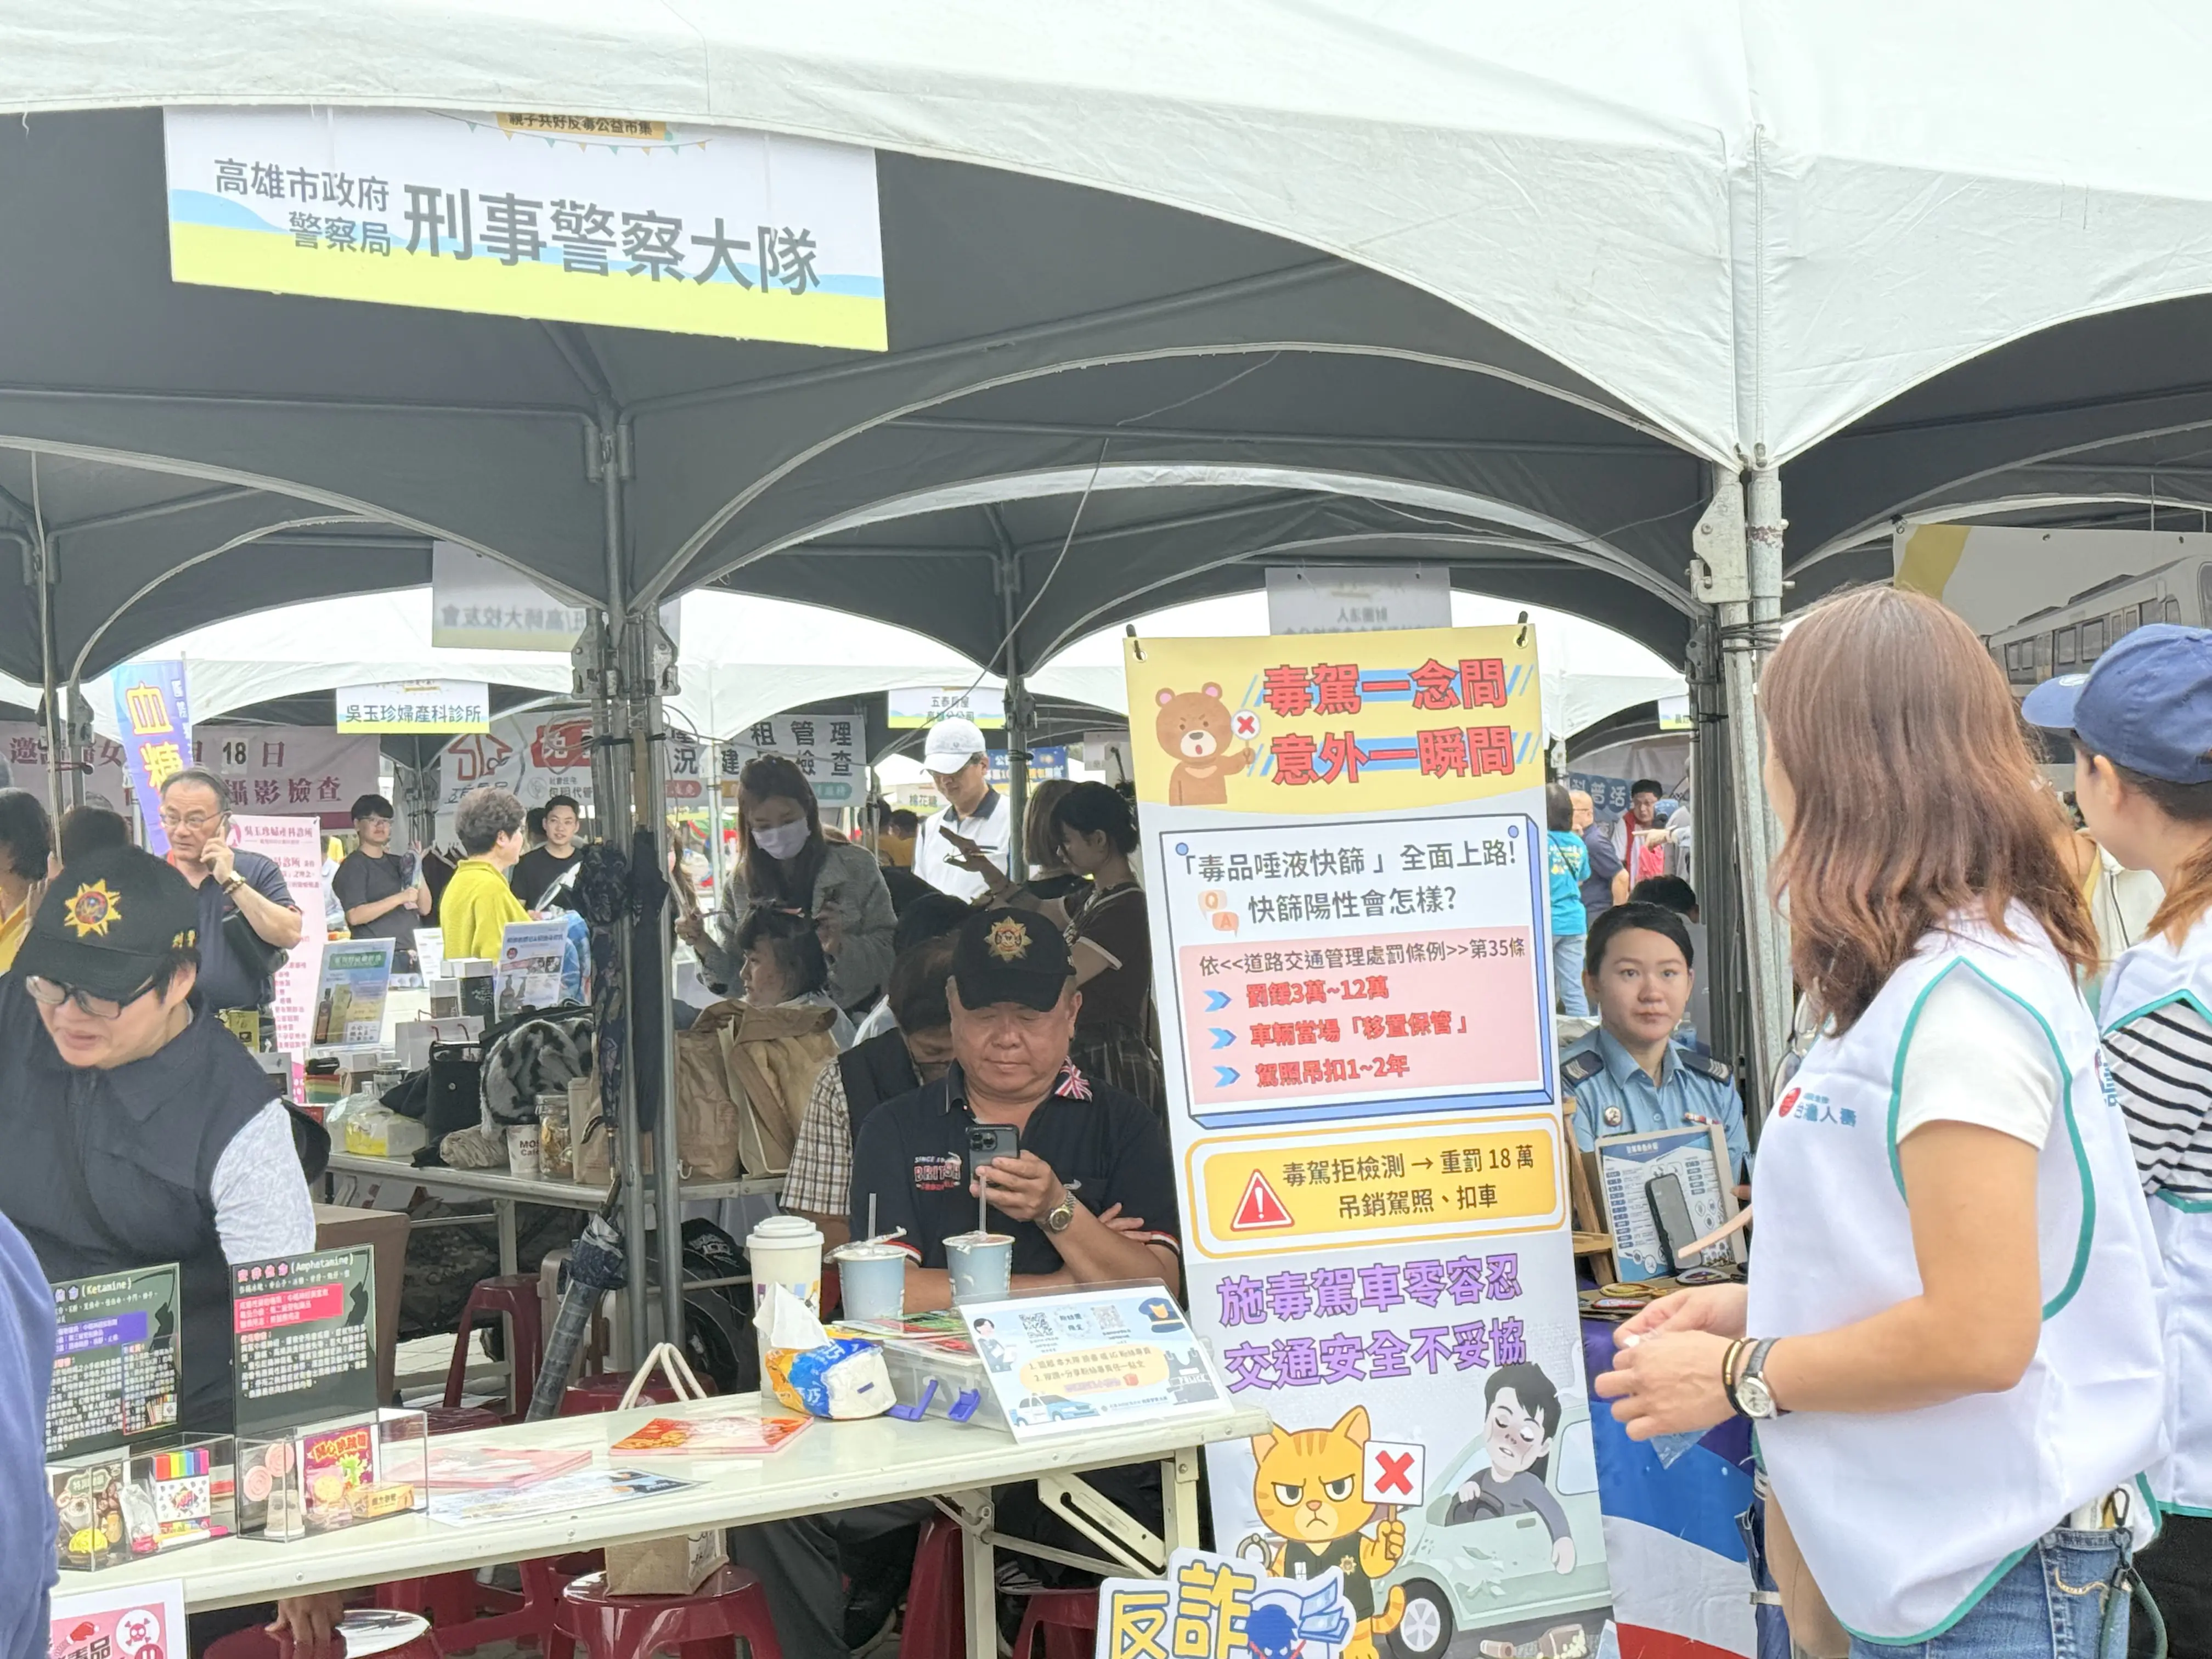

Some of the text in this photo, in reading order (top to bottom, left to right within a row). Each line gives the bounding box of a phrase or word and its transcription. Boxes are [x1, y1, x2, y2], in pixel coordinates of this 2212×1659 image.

[215, 157, 390, 212] 高雄市政府
[289, 212, 391, 258] 警察局
[404, 184, 820, 295] 刑事警察大隊
[1263, 658, 1509, 717] 毒駕一念間
[346, 704, 481, 723] 吳玉珍婦產科診所
[223, 742, 246, 764] 18
[1271, 726, 1516, 786] 意外一瞬間
[1248, 887, 1456, 924] 快篩陽性會怎樣?
[1283, 1153, 1404, 1187] 毒駕拒檢測
[1339, 1183, 1498, 1219] 吊銷駕照、扣車
[1217, 1254, 1522, 1328] 施毒駕車零容忍
[1224, 1317, 1527, 1393] 交通安全不妥協
